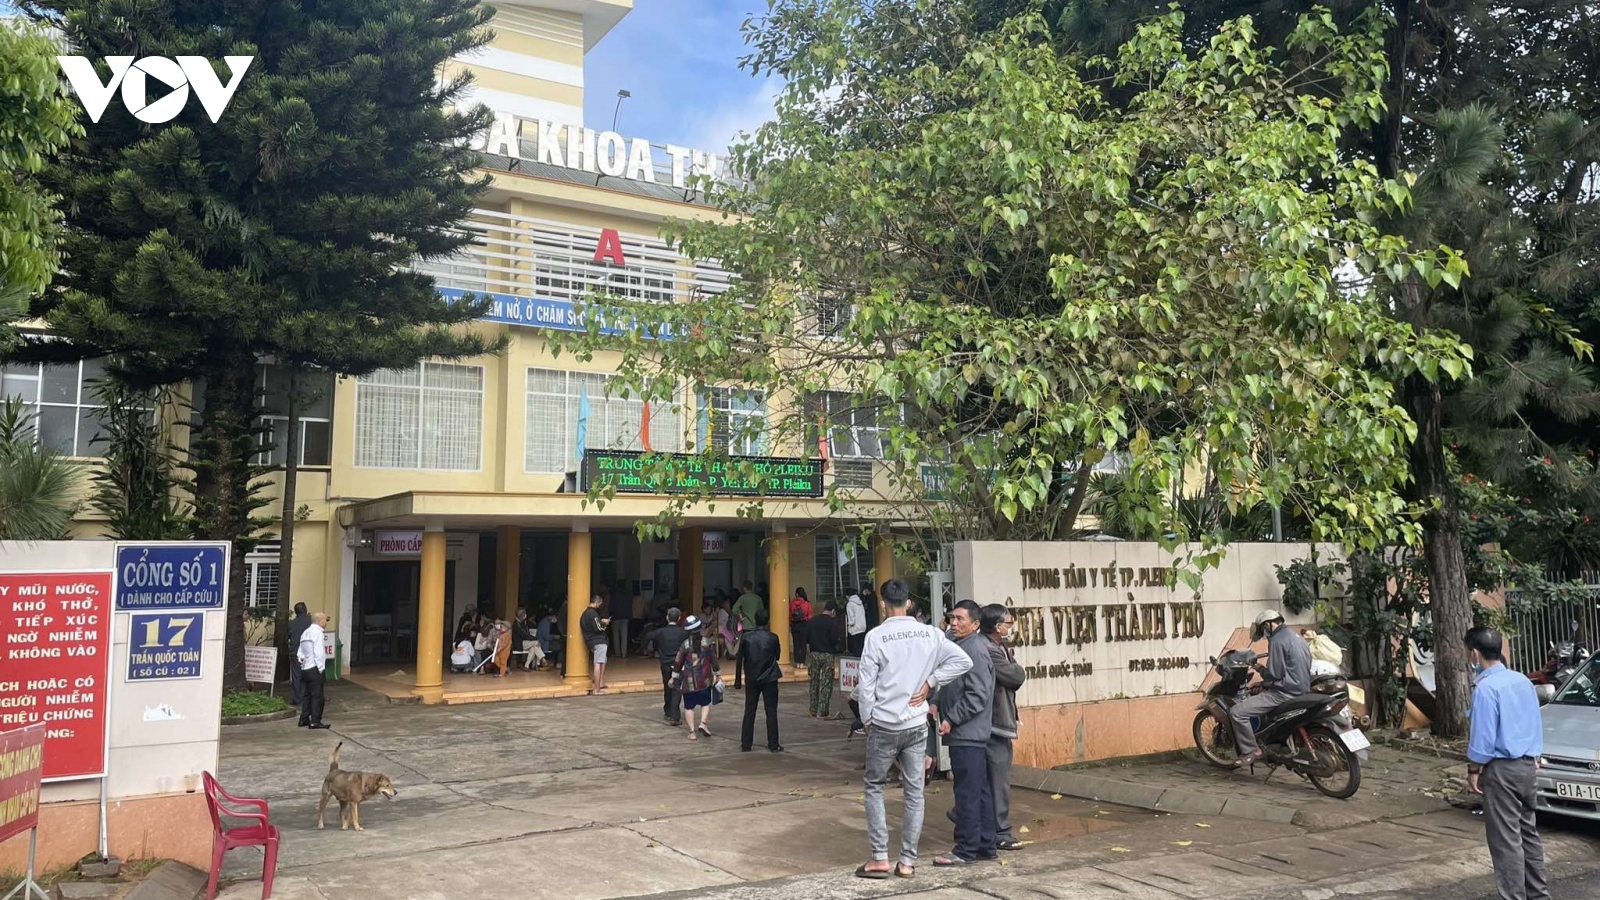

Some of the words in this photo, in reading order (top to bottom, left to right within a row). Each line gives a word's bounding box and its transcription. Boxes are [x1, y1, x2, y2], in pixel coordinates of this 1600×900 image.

[538, 119, 655, 184] KHOA
[593, 228, 625, 265] A
[536, 305, 564, 324] CHĂM
[596, 457, 643, 470] TRUNG
[601, 473, 615, 485] 17
[618, 470, 641, 485] Trần
[783, 478, 811, 490] Pleiku
[380, 536, 406, 551] PHÒNG
[407, 534, 423, 551] CẤP
[123, 548, 174, 587] CỔNG
[179, 550, 204, 586] SỐ
[209, 562, 217, 585] 1
[1020, 567, 1061, 590] TRUNG
[1088, 567, 1098, 588] Y
[18, 583, 47, 595] MŨI
[55, 583, 99, 595] NƯỚC,
[127, 590, 152, 605] DÀNH
[154, 593, 173, 604] CHO
[175, 588, 192, 604] CẤP
[194, 589, 212, 603] CỨU
[12, 598, 46, 611] KHÓ
[15, 613, 53, 627] TIẾP
[65, 613, 98, 626] XÚC
[1101, 592, 1167, 643] THÀNH
[7, 630, 38, 643] NGỜ
[49, 627, 97, 642] NHIỄM
[139, 616, 195, 648] 17
[881, 630, 931, 643] BALENCAIGA
[9, 646, 61, 659] KHÔNG
[67, 644, 97, 656] VÀO
[155, 648, 176, 665] QUỐC
[178, 647, 199, 663] TOẢN
[139, 666, 152, 677] SỐ
[177, 666, 189, 675] 02
[27, 678, 68, 692] HOẶC
[74, 675, 94, 688] CÓ
[0, 694, 37, 708] GƯỜI
[46, 690, 94, 705] NHIỄM
[0, 710, 38, 724] RIỆU
[43, 707, 94, 721] CHỨNG
[44, 729, 75, 739] NG:
